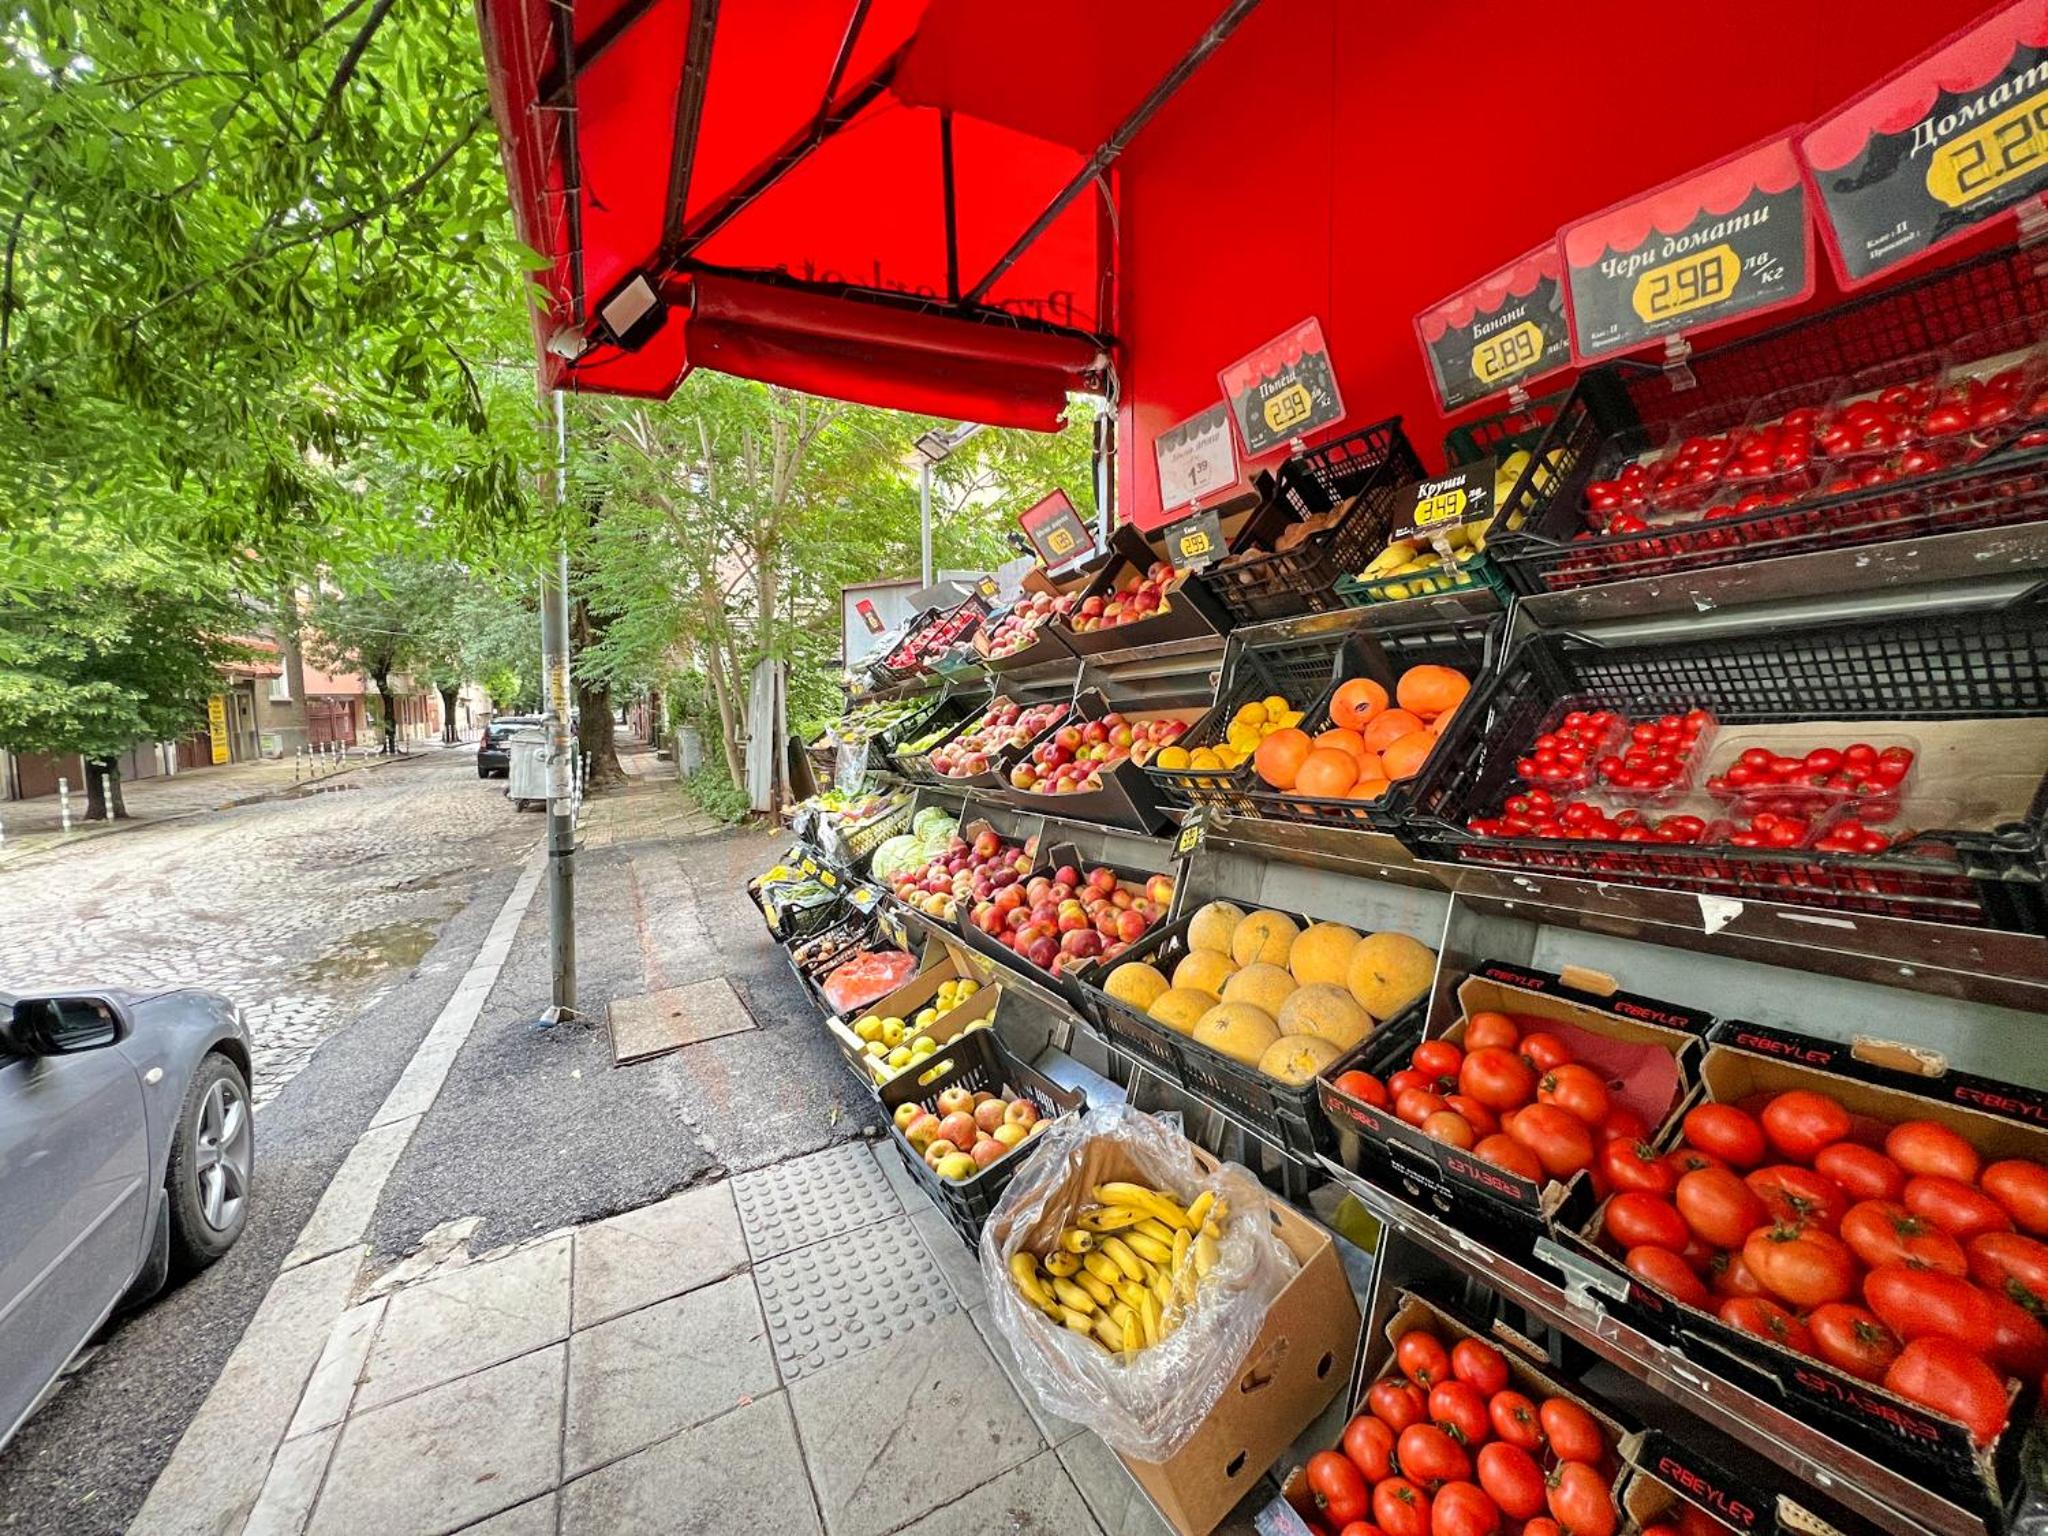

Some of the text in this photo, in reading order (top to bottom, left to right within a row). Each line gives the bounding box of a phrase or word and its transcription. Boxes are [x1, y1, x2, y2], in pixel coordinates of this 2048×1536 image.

[1601, 205, 1770, 279] Чери домати
[1649, 255, 1724, 313] 2.98
[1472, 303, 1527, 339] Банани
[1482, 329, 1535, 377] 2.89
[1417, 474, 1467, 499] Круши
[1614, 1001, 1689, 1028] ERBEYLER
[1735, 1033, 1832, 1065] ERBEYLER
[1658, 1457, 1756, 1527] ERBEYLER
